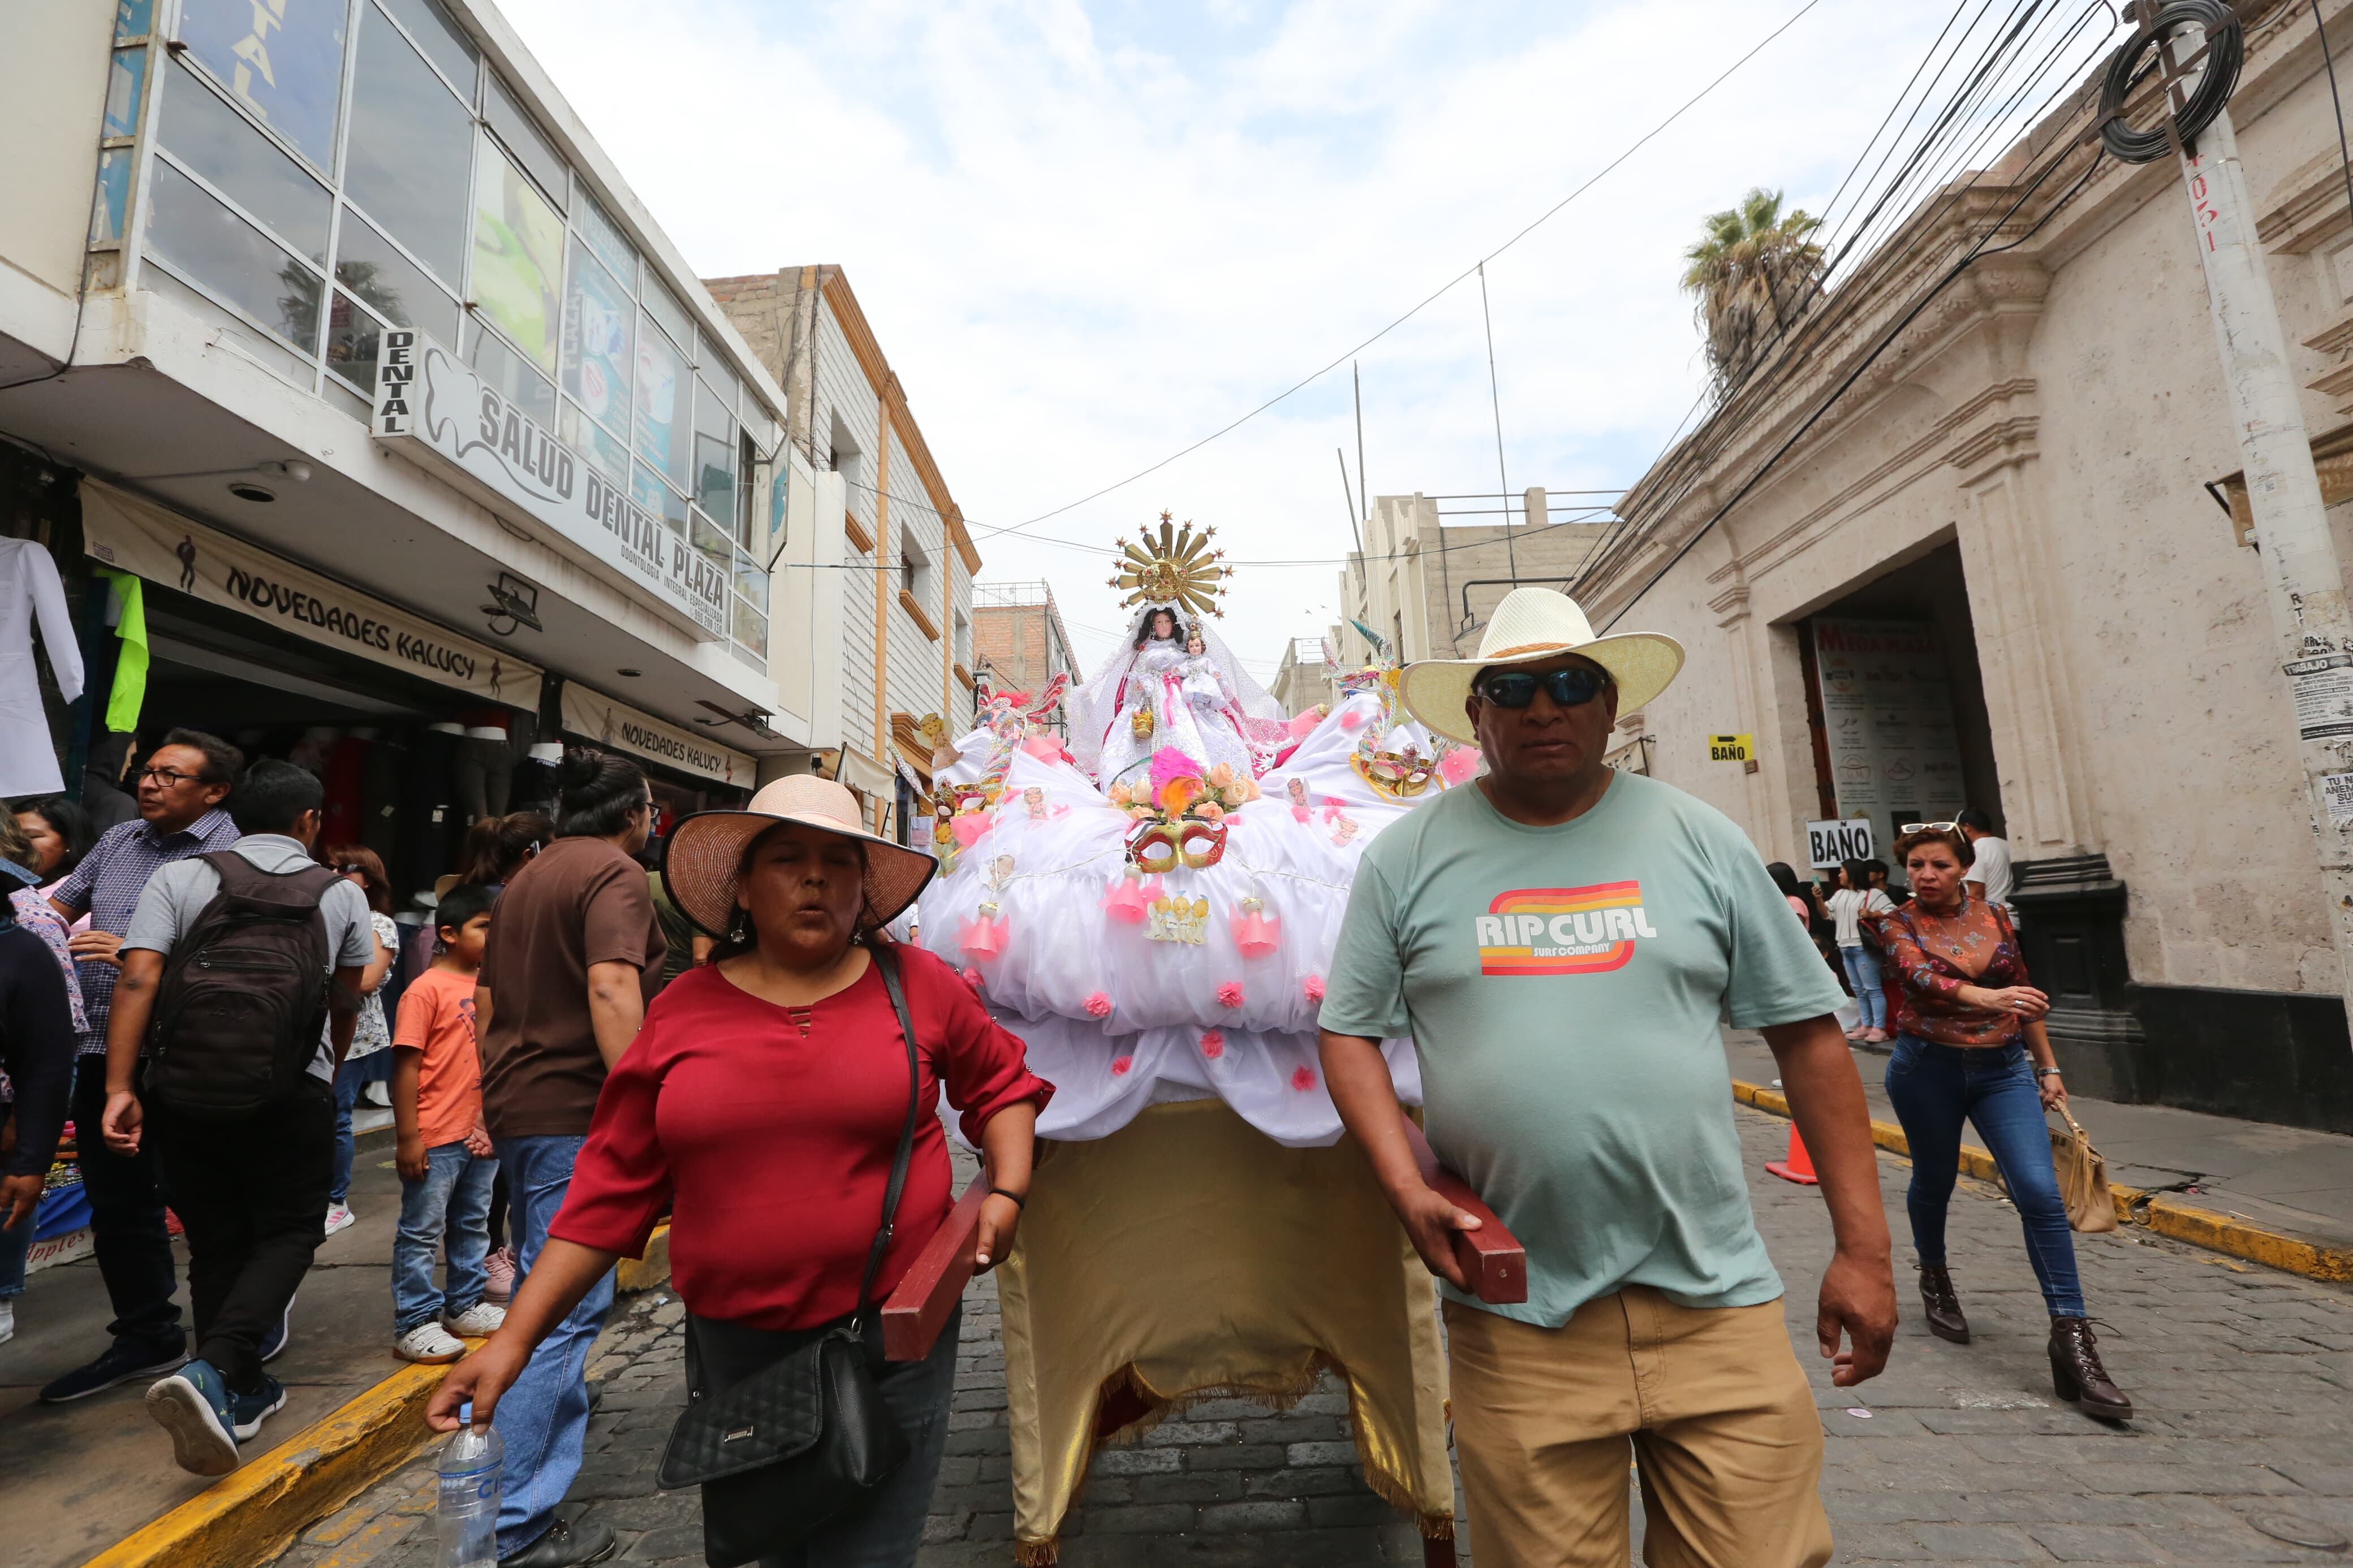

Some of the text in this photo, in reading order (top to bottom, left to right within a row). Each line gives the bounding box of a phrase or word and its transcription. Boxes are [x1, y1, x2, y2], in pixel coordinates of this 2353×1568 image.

[231, 0, 286, 118] TAL
[380, 332, 414, 433] DENTAL
[479, 387, 575, 500] SALUD
[585, 468, 665, 568] DENTAL
[673, 537, 724, 610] PLAZA
[621, 545, 722, 625] ODONTOLOGIA INTEGRAL ESPECIALIZADA
[226, 566, 475, 680] NOVEDADES KALUCY
[694, 610, 722, 636] 990 200 150
[2284, 659, 2328, 675] TRABAJO
[536, 758, 557, 768] PINK
[622, 722, 721, 772] NOVEDADES KALUCY
[1712, 744, 1746, 761] BAÑO
[2326, 776, 2341, 786] TU
[1810, 820, 1870, 862] BAÑO
[1476, 908, 1657, 946] RIP CURL
[1533, 943, 1610, 957] SURF COMPANY
